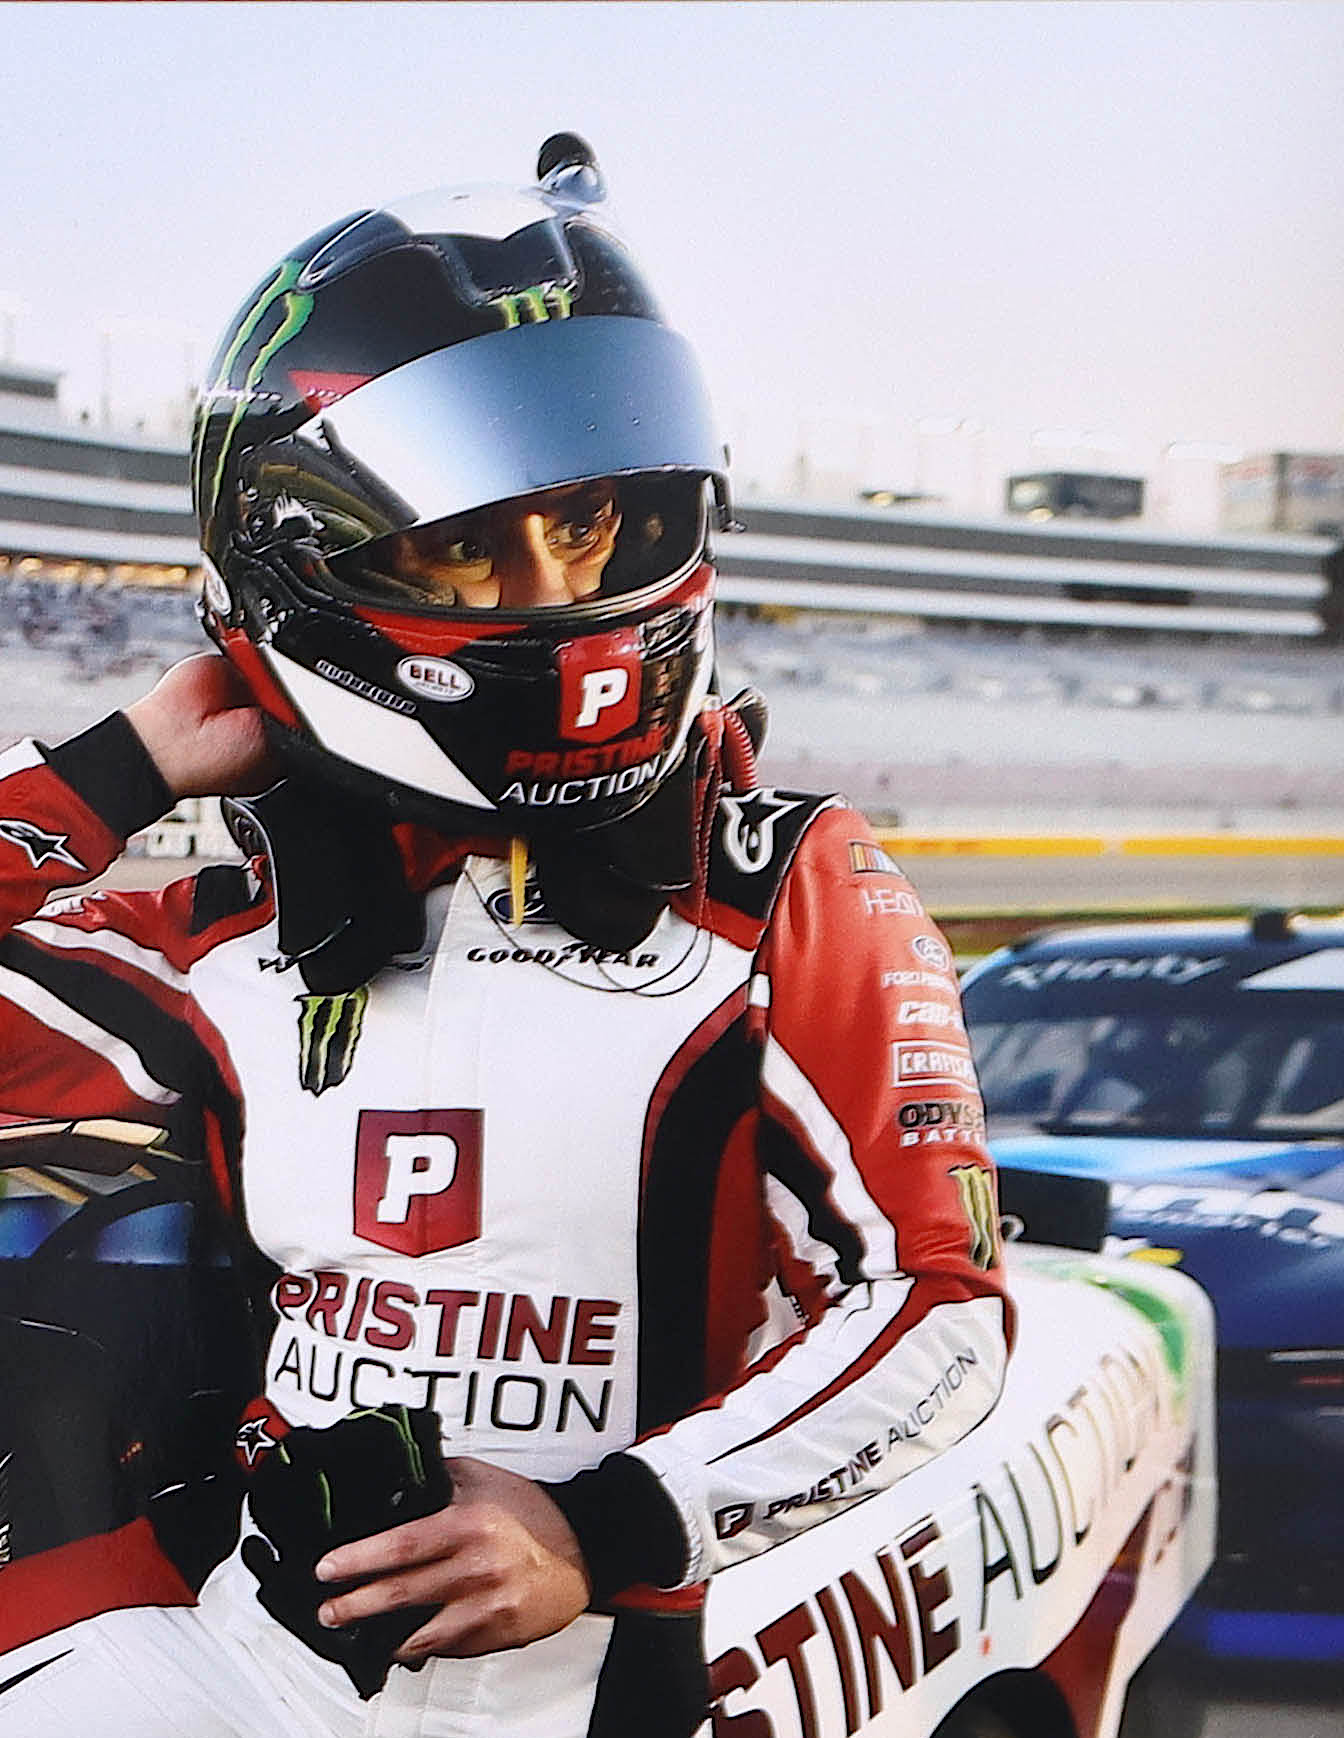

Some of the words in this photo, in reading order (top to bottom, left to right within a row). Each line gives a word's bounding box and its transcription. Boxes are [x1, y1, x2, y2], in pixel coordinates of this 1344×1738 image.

[409, 663, 462, 689] BELL
[575, 667, 629, 728] P
[498, 754, 662, 806] AUCTION
[376, 1132, 459, 1224] P
[274, 1271, 622, 1365] PRISTINE
[274, 1337, 613, 1433] AUCTION
[763, 1441, 881, 1519] PRISTINE
[887, 1349, 977, 1451] AUCTION
